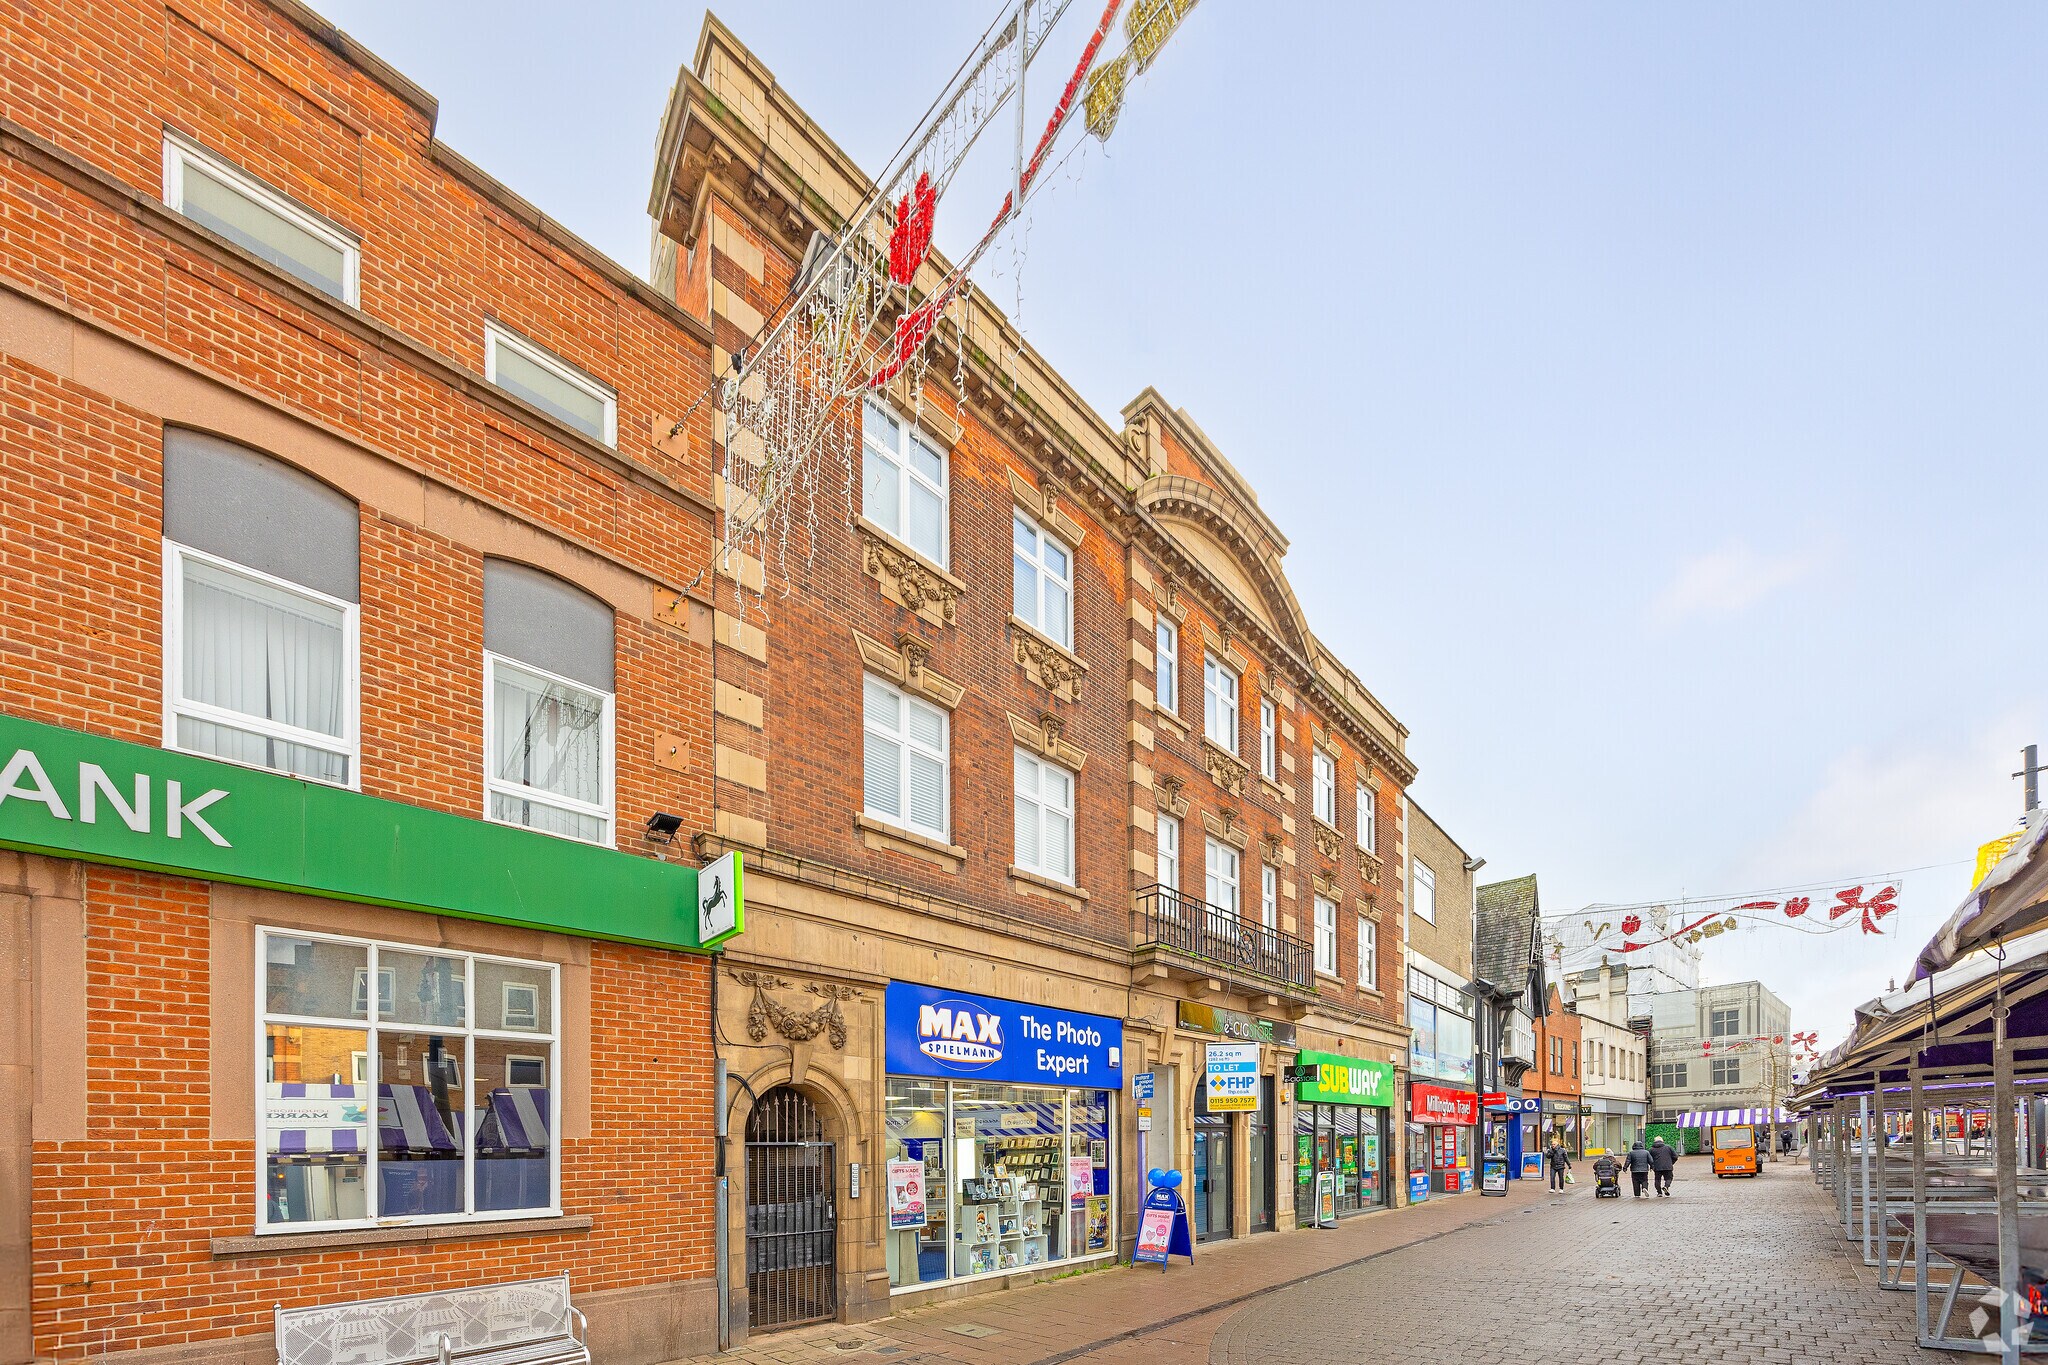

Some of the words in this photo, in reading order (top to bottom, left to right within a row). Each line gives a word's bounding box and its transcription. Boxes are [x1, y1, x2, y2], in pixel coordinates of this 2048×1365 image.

[919, 1004, 1002, 1045] MAX
[1020, 1015, 1052, 1041] The
[1056, 1021, 1101, 1047] Photo
[928, 1043, 995, 1059] SPIELMANN
[1037, 1048, 1089, 1078] Expert
[1227, 1076, 1255, 1089] FHP
[1318, 1063, 1382, 1096] SUBWAY
[1426, 1094, 1455, 1117] Millington
[1456, 1099, 1471, 1115] Travel
